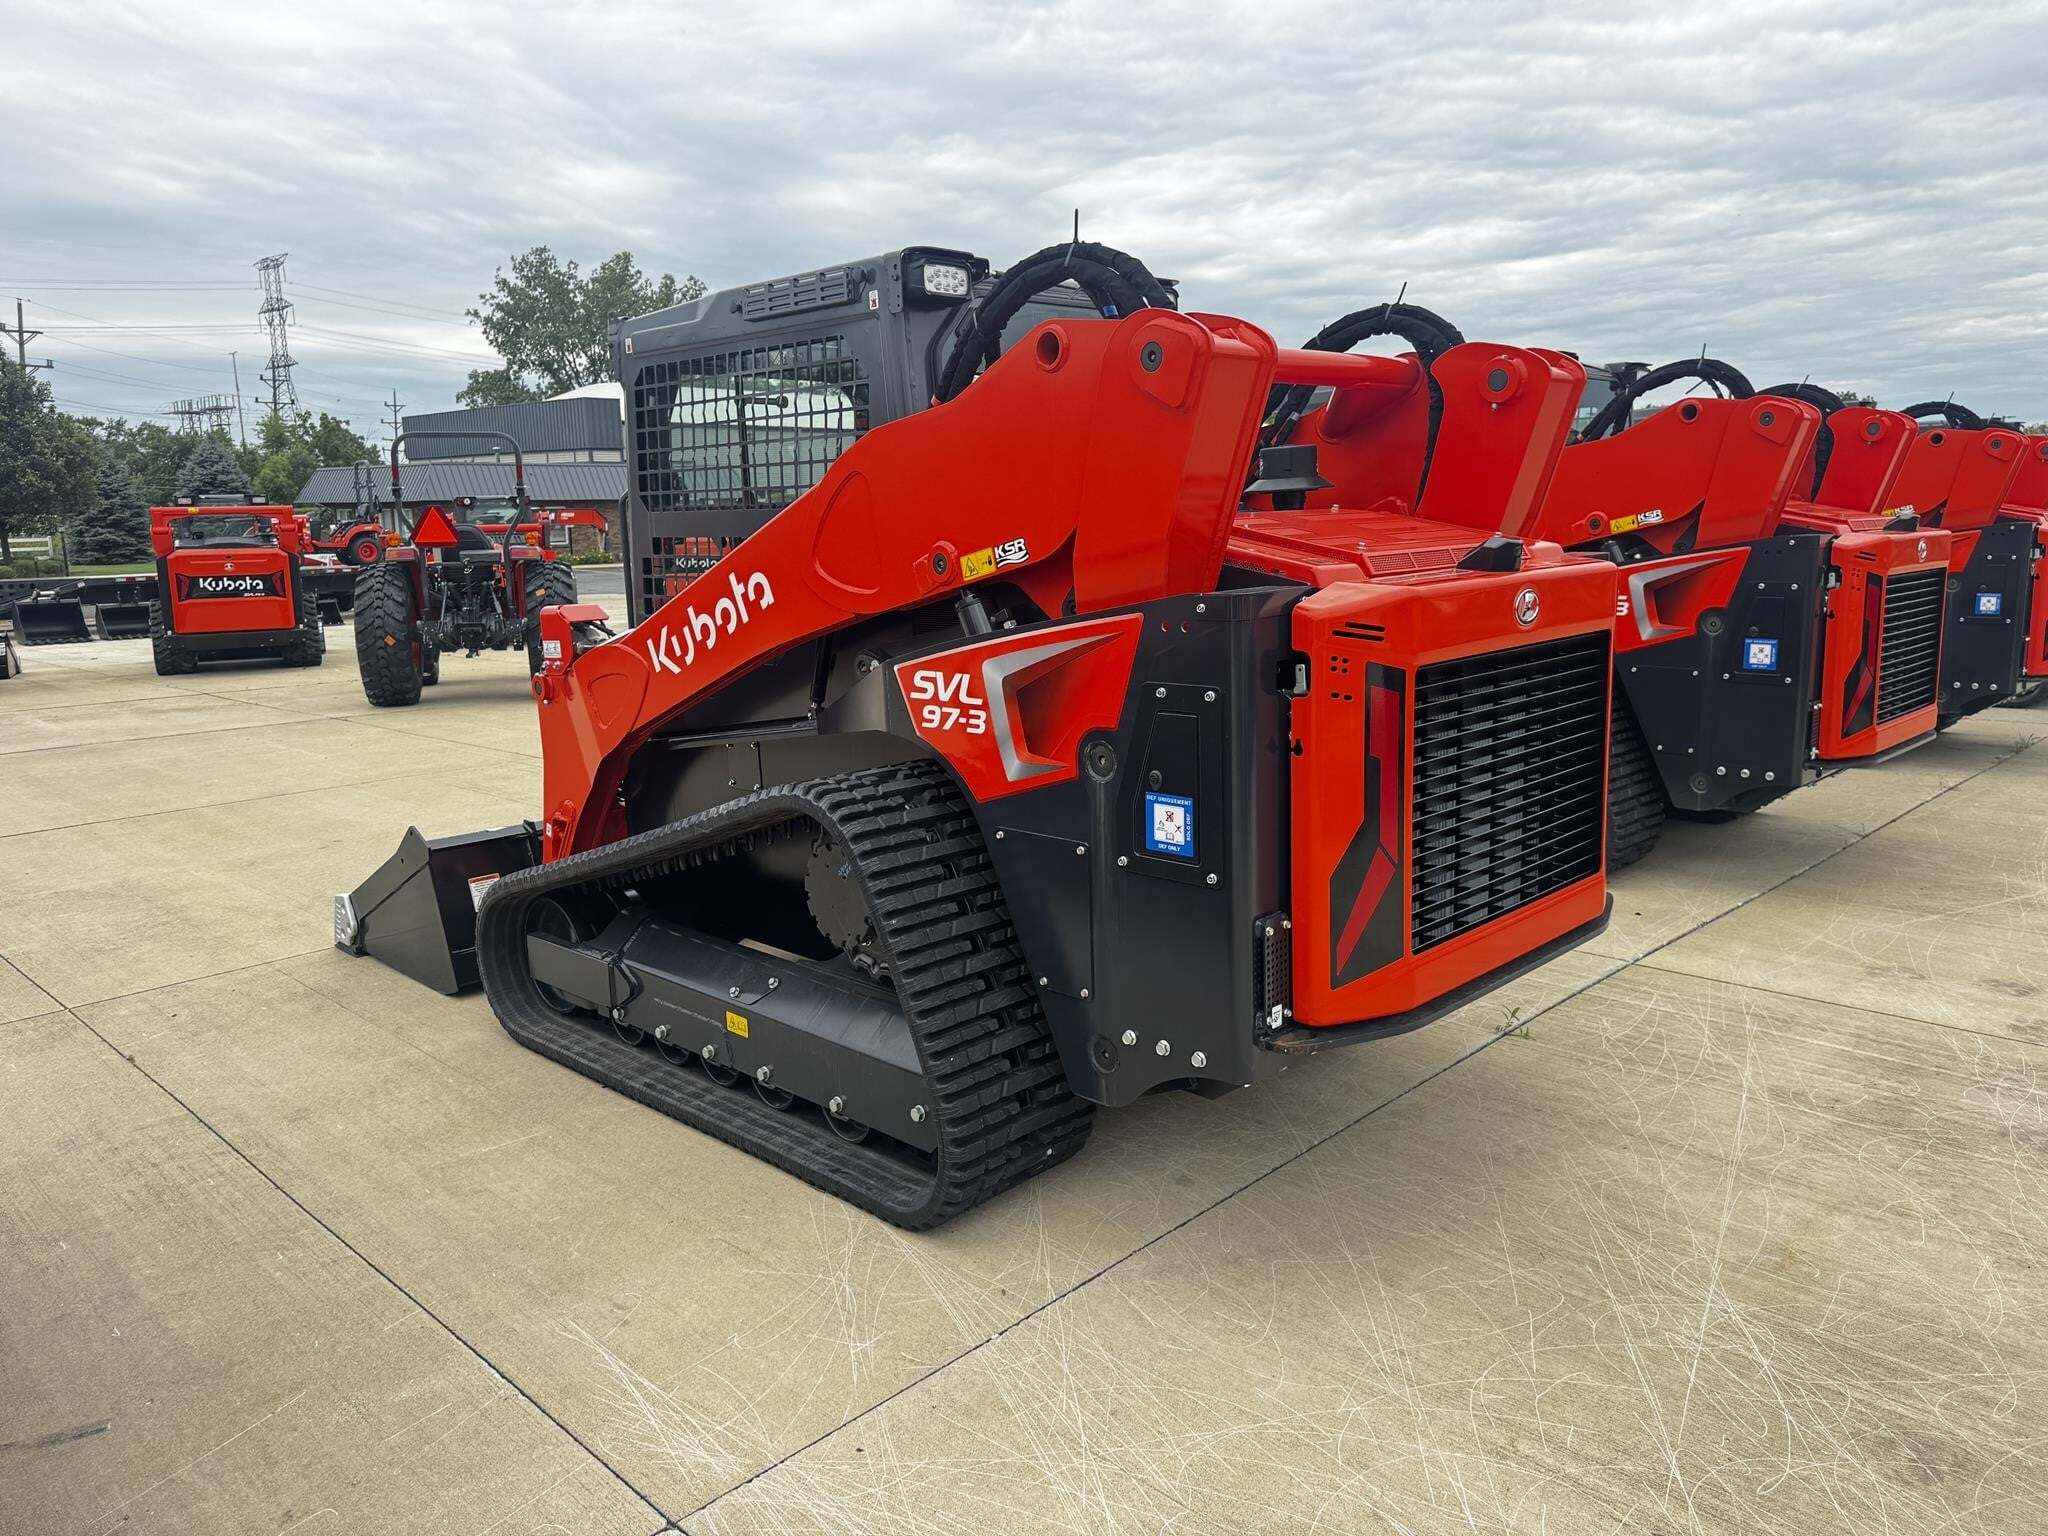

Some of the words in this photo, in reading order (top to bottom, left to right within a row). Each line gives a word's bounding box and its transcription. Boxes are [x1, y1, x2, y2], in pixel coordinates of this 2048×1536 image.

[1637, 509, 1662, 523] KSR
[994, 538, 1026, 559] KSR
[199, 576, 264, 591] Kubota
[646, 571, 775, 675] Kubota
[910, 669, 984, 705] SVL
[921, 704, 987, 734] 97-3
